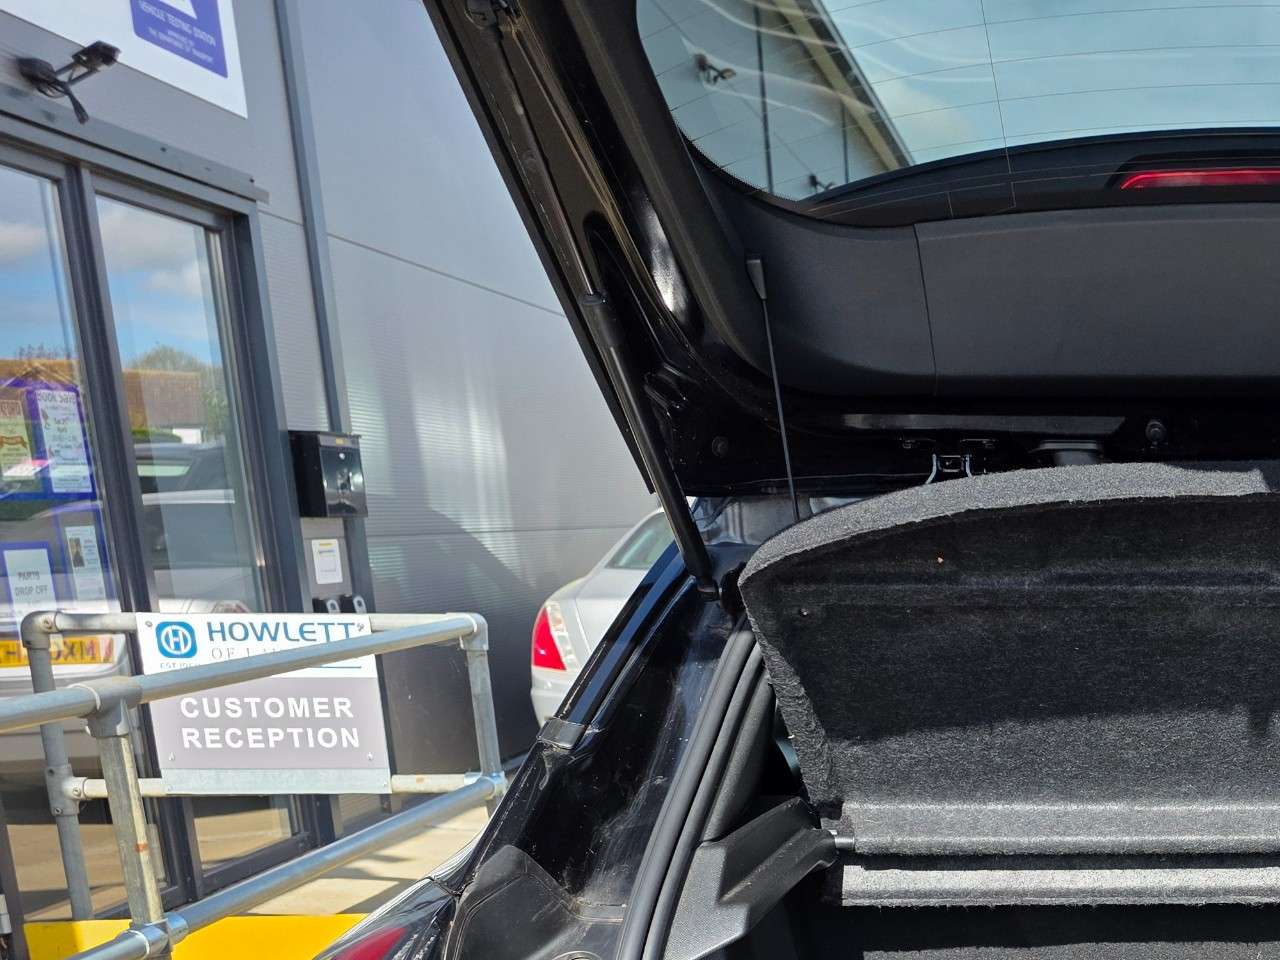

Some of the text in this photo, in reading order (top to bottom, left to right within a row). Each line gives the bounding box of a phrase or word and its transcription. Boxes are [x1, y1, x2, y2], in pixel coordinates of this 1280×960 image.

[207, 621, 355, 643] HOWLETT
[180, 697, 354, 718] CUSTOMER
[181, 727, 360, 748] RECEPTION
